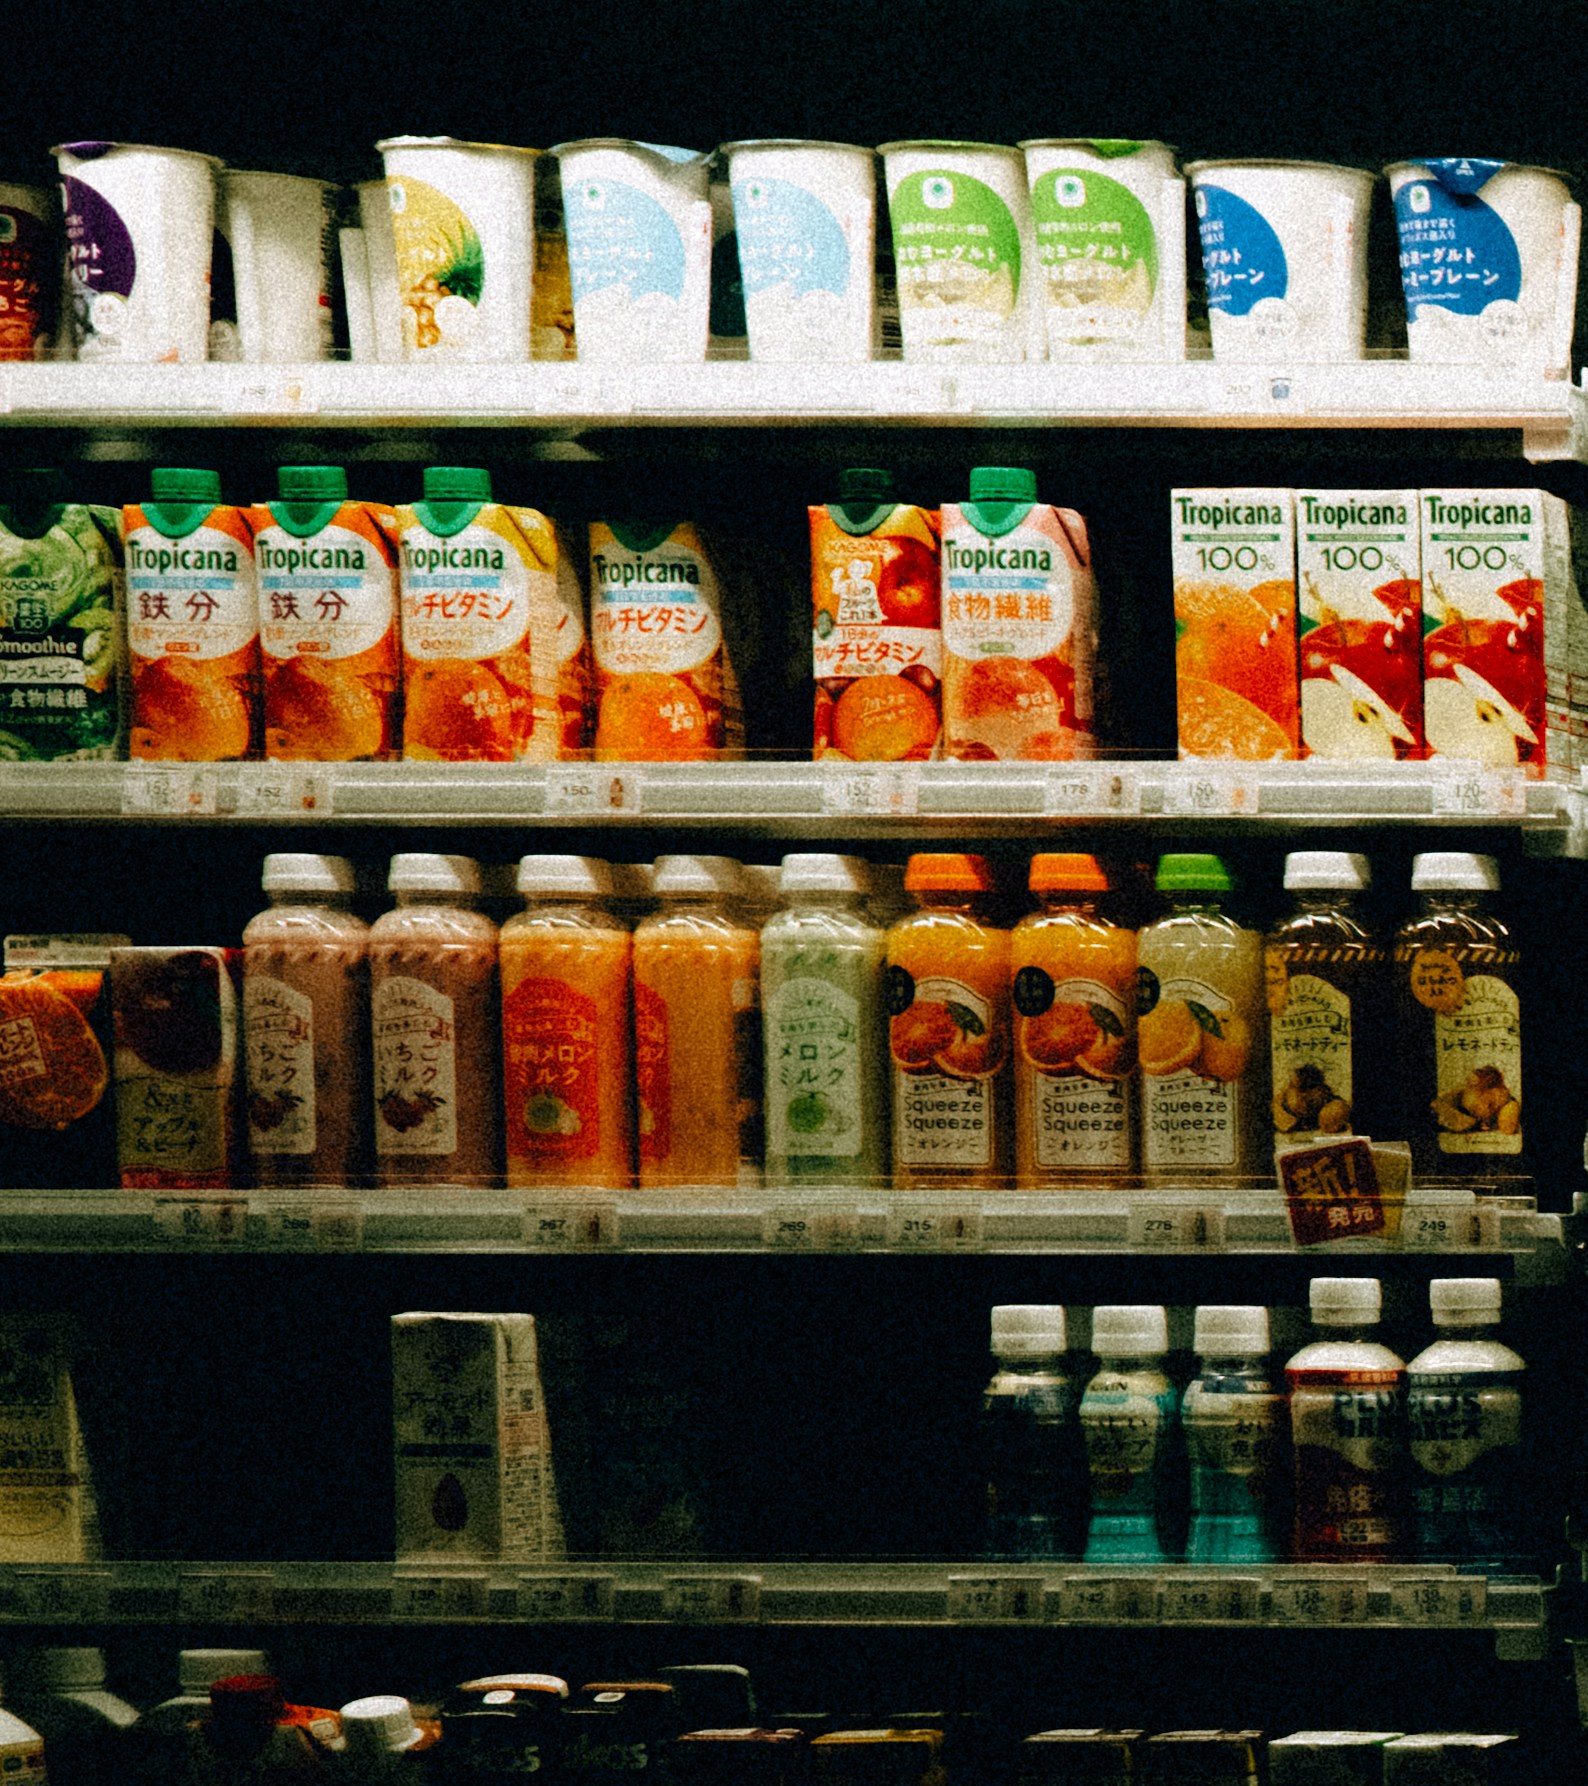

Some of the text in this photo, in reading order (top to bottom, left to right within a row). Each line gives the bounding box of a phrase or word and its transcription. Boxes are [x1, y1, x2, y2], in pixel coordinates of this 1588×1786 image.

[1177, 496, 1283, 530] Tropicana
[1302, 496, 1408, 530] Tropicana
[1427, 496, 1533, 530] Tropicana
[127, 540, 238, 575] Tropicana
[257, 539, 366, 574] Tropicana
[401, 540, 505, 571] Tropicana
[945, 539, 1052, 573] Tropicana
[1196, 545, 1276, 572] 100%
[1320, 545, 1400, 572] 100%
[1445, 545, 1525, 572] 100%
[592, 554, 700, 588] Tropicana
[139, 590, 220, 622] 鉄分
[270, 590, 350, 622] 鉄分
[779, 1043, 846, 1062] メロン
[779, 1066, 846, 1087] ミルク
[904, 1100, 983, 1115] Squeeze
[1043, 1099, 1123, 1116] Squeeze
[1151, 1099, 1227, 1115] Squeeze
[904, 1116, 983, 1132] Squeeze
[1043, 1116, 1124, 1133] Squeeze
[1151, 1115, 1227, 1132] Squeeze
[1291, 1152, 1361, 1212] 新!
[1327, 1203, 1378, 1231] 発売
